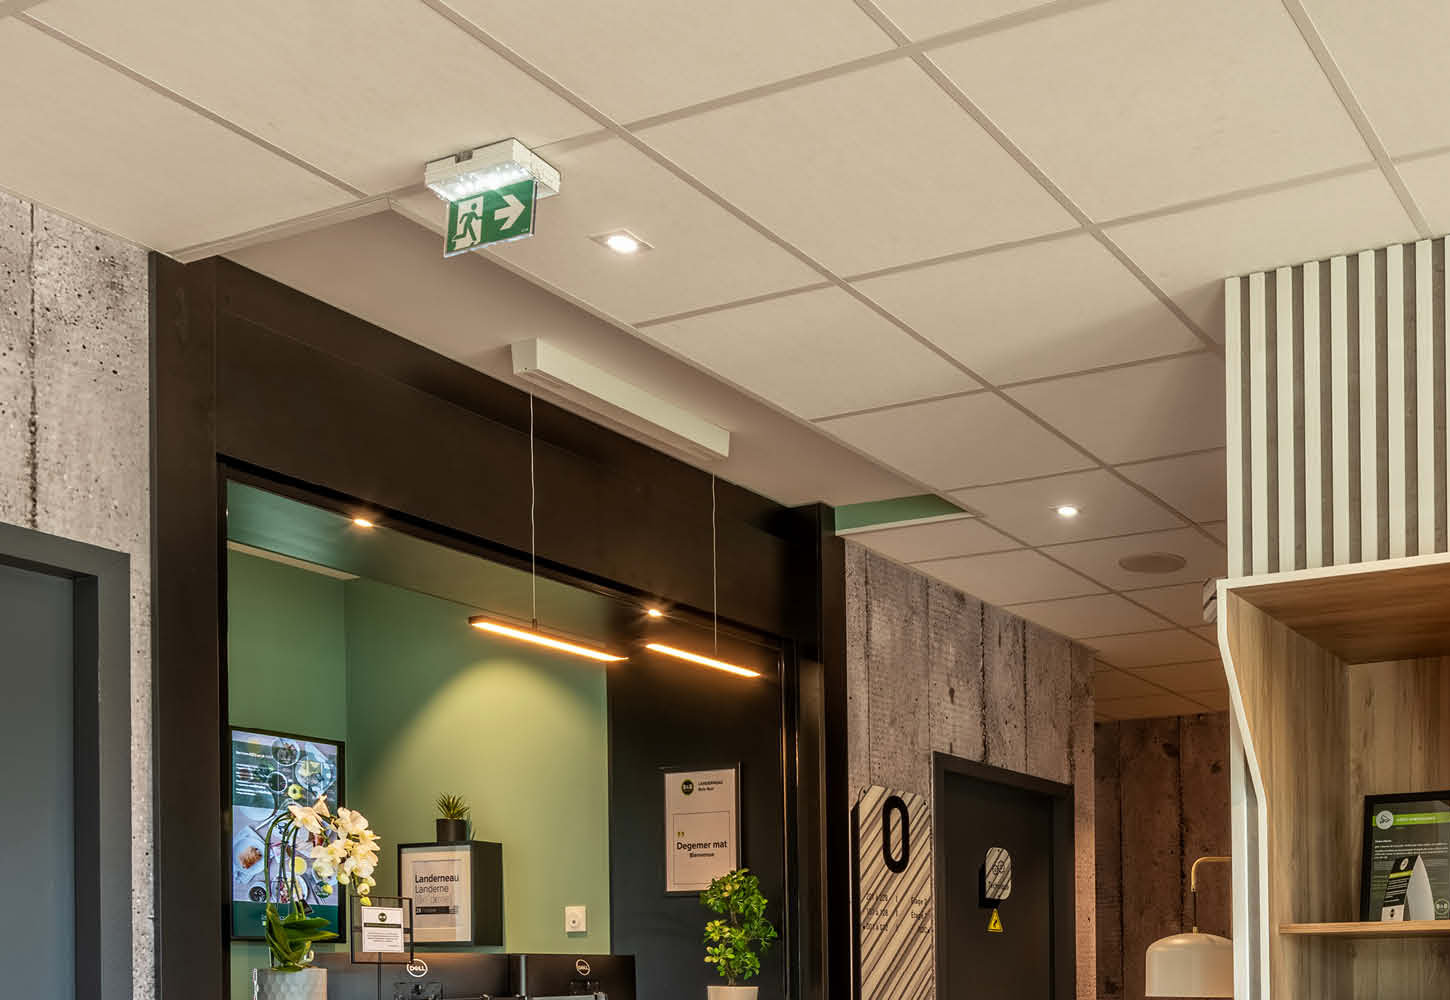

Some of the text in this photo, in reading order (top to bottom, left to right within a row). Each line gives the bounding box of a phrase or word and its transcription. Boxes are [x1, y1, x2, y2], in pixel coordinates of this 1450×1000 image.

[882, 795, 909, 873] 0
[676, 840, 727, 851] Degemer mat
[415, 873, 459, 884] Landerneau
[415, 884, 449, 893] Landerne
[409, 964, 426, 972] DELL
